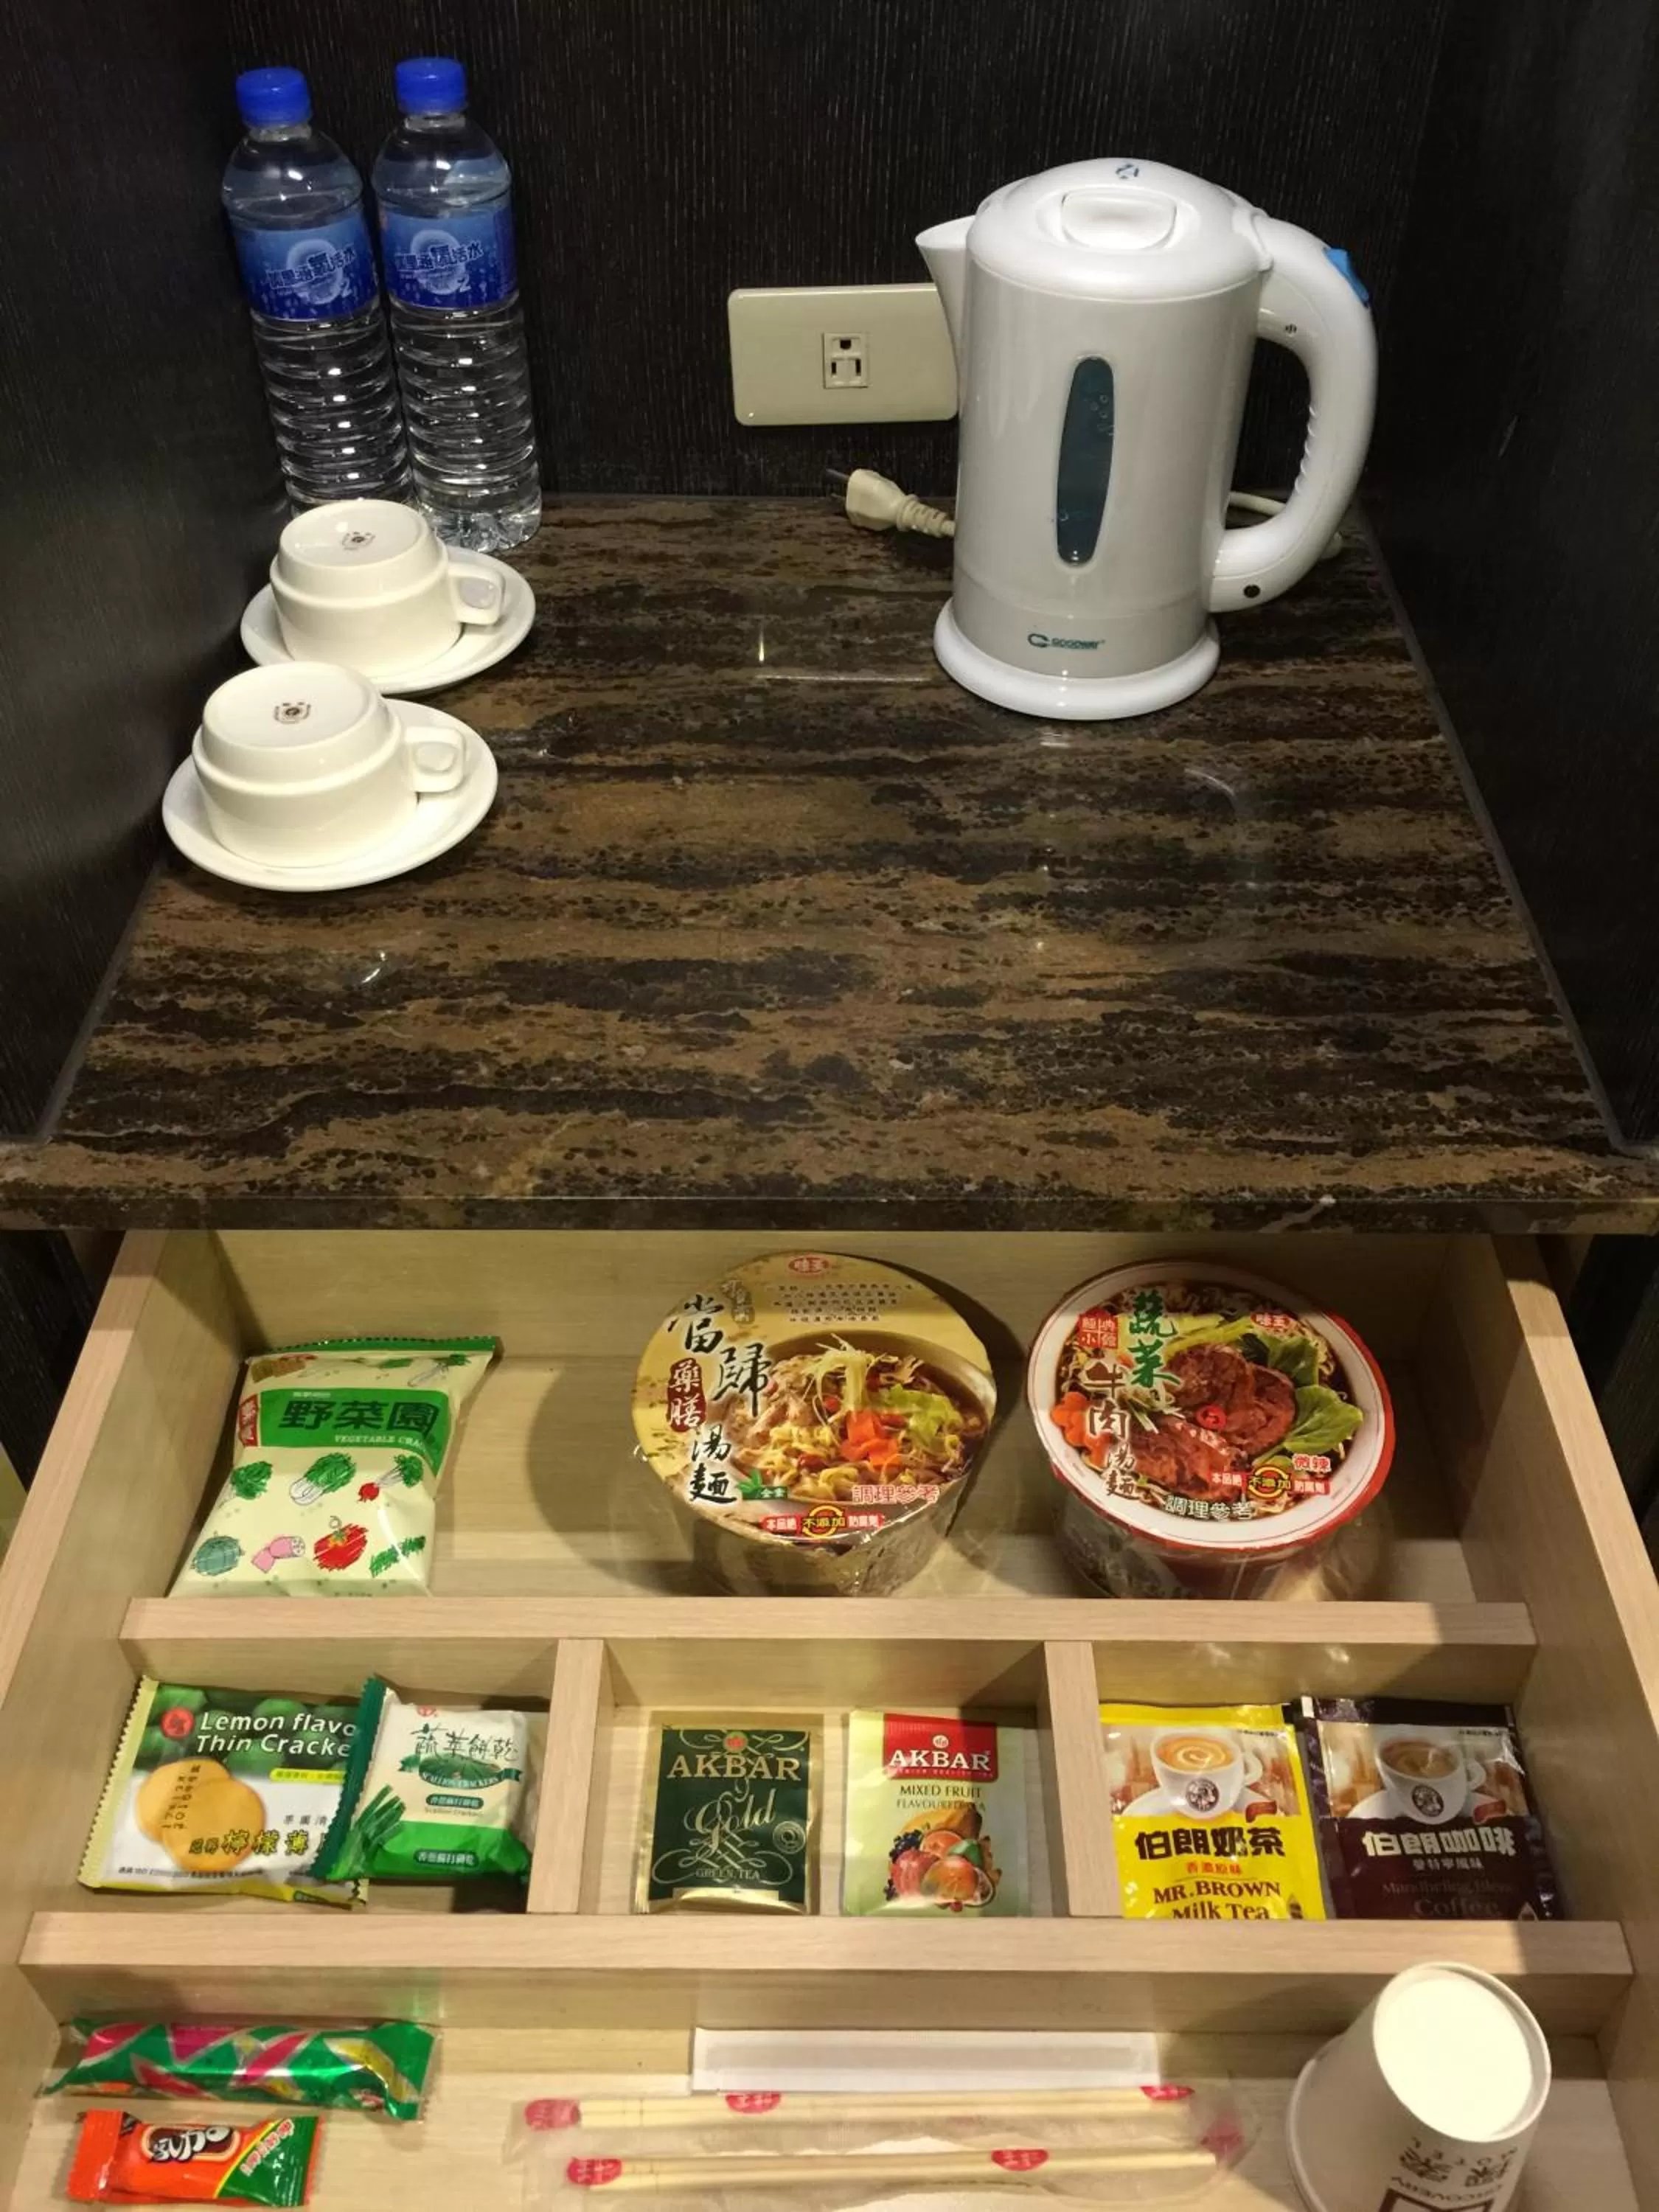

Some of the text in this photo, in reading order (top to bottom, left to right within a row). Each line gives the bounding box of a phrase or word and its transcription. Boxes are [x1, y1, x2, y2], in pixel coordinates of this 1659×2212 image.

[279, 1401, 439, 1439] 野菜園
[200, 1711, 285, 1732] Lemon
[292, 1713, 358, 1737] flavo
[196, 1733, 351, 1757] Thin Cracke
[667, 1753, 802, 1781] AKBAR
[888, 1749, 992, 1770] AKBAR
[900, 1784, 980, 1798] MIXED FRUIT
[1135, 1826, 1285, 1860] 伯朗奶茶
[1362, 1826, 1517, 1857] 伯朗咖啡
[1225, 1904, 1270, 1920] Tea
